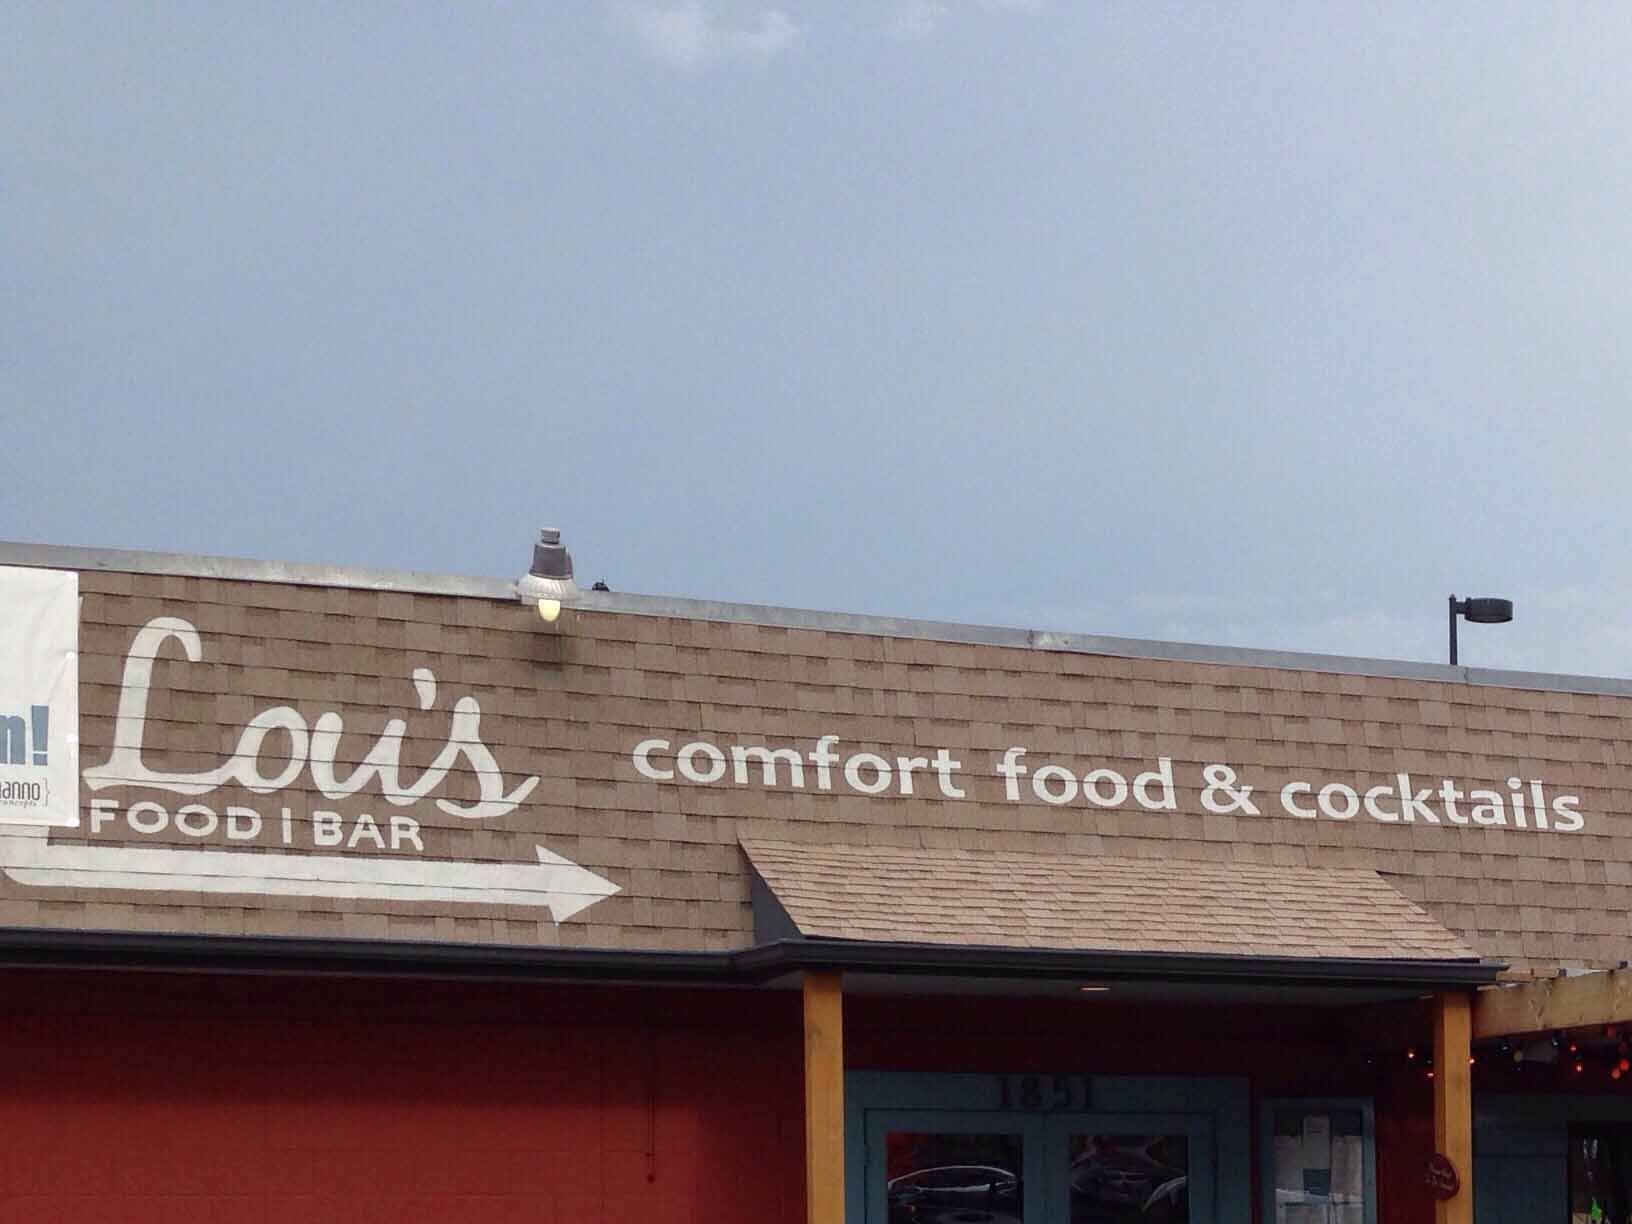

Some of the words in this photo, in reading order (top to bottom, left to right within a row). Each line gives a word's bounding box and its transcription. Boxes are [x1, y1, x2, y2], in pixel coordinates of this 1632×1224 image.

[82, 616, 540, 818] Lou's
[0, 781, 40, 801] anno
[632, 735, 966, 798] comfort
[996, 747, 1177, 810] food
[1200, 764, 1261, 815] &
[1280, 773, 1585, 831] cocktails
[90, 799, 262, 840] FOOD
[312, 810, 424, 850] BAR
